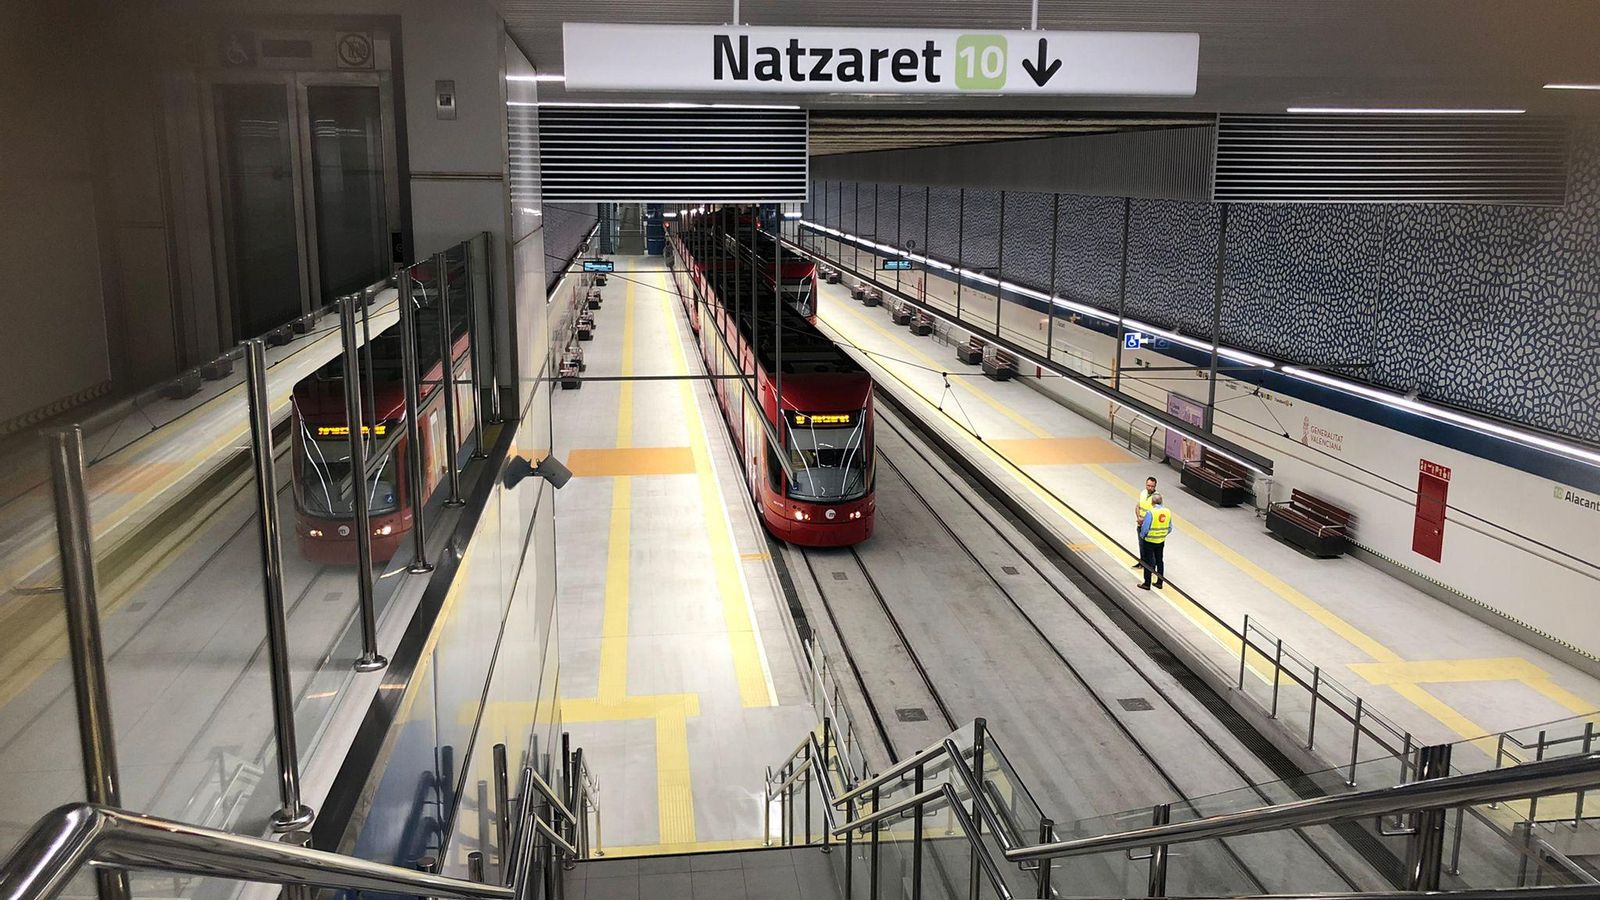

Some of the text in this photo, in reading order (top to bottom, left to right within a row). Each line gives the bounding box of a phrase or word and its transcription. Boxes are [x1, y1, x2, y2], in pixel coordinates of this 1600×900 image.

[713, 35, 1004, 82] Natzaret 10
[1310, 425, 1344, 443] GENERALITAT
[1310, 434, 1342, 452] VALENCIANA
